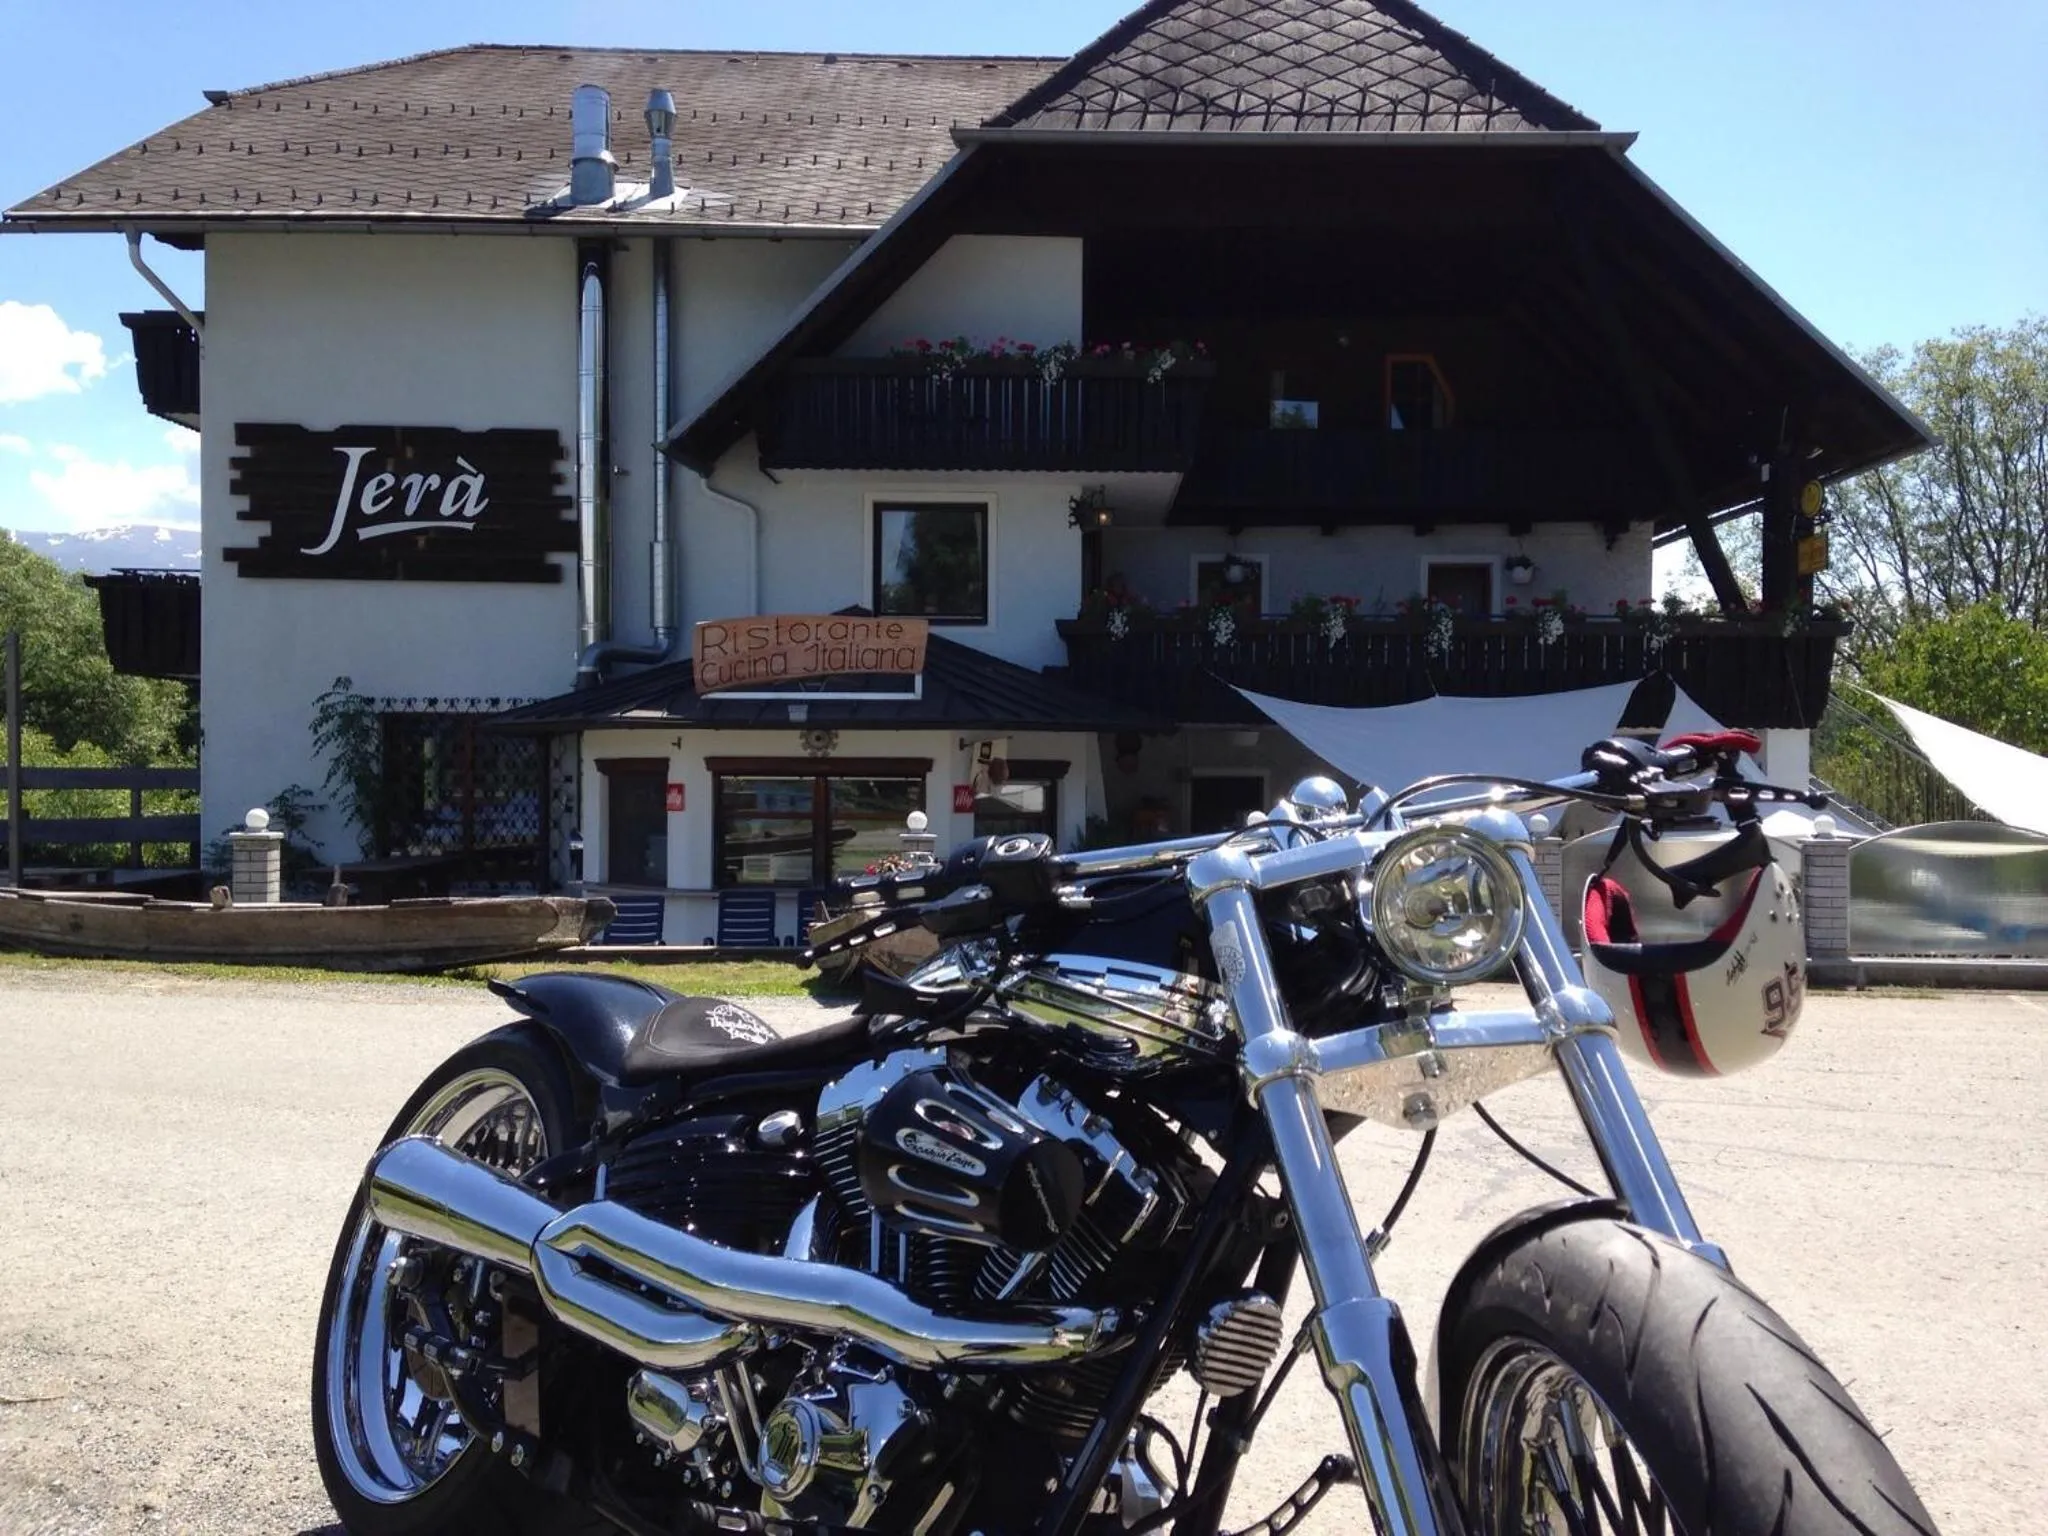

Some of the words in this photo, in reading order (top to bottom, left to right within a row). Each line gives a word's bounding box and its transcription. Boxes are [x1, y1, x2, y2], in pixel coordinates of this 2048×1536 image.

[300, 447, 490, 555] Jerà
[700, 616, 904, 662] Ristorante
[701, 652, 788, 688] Cucina
